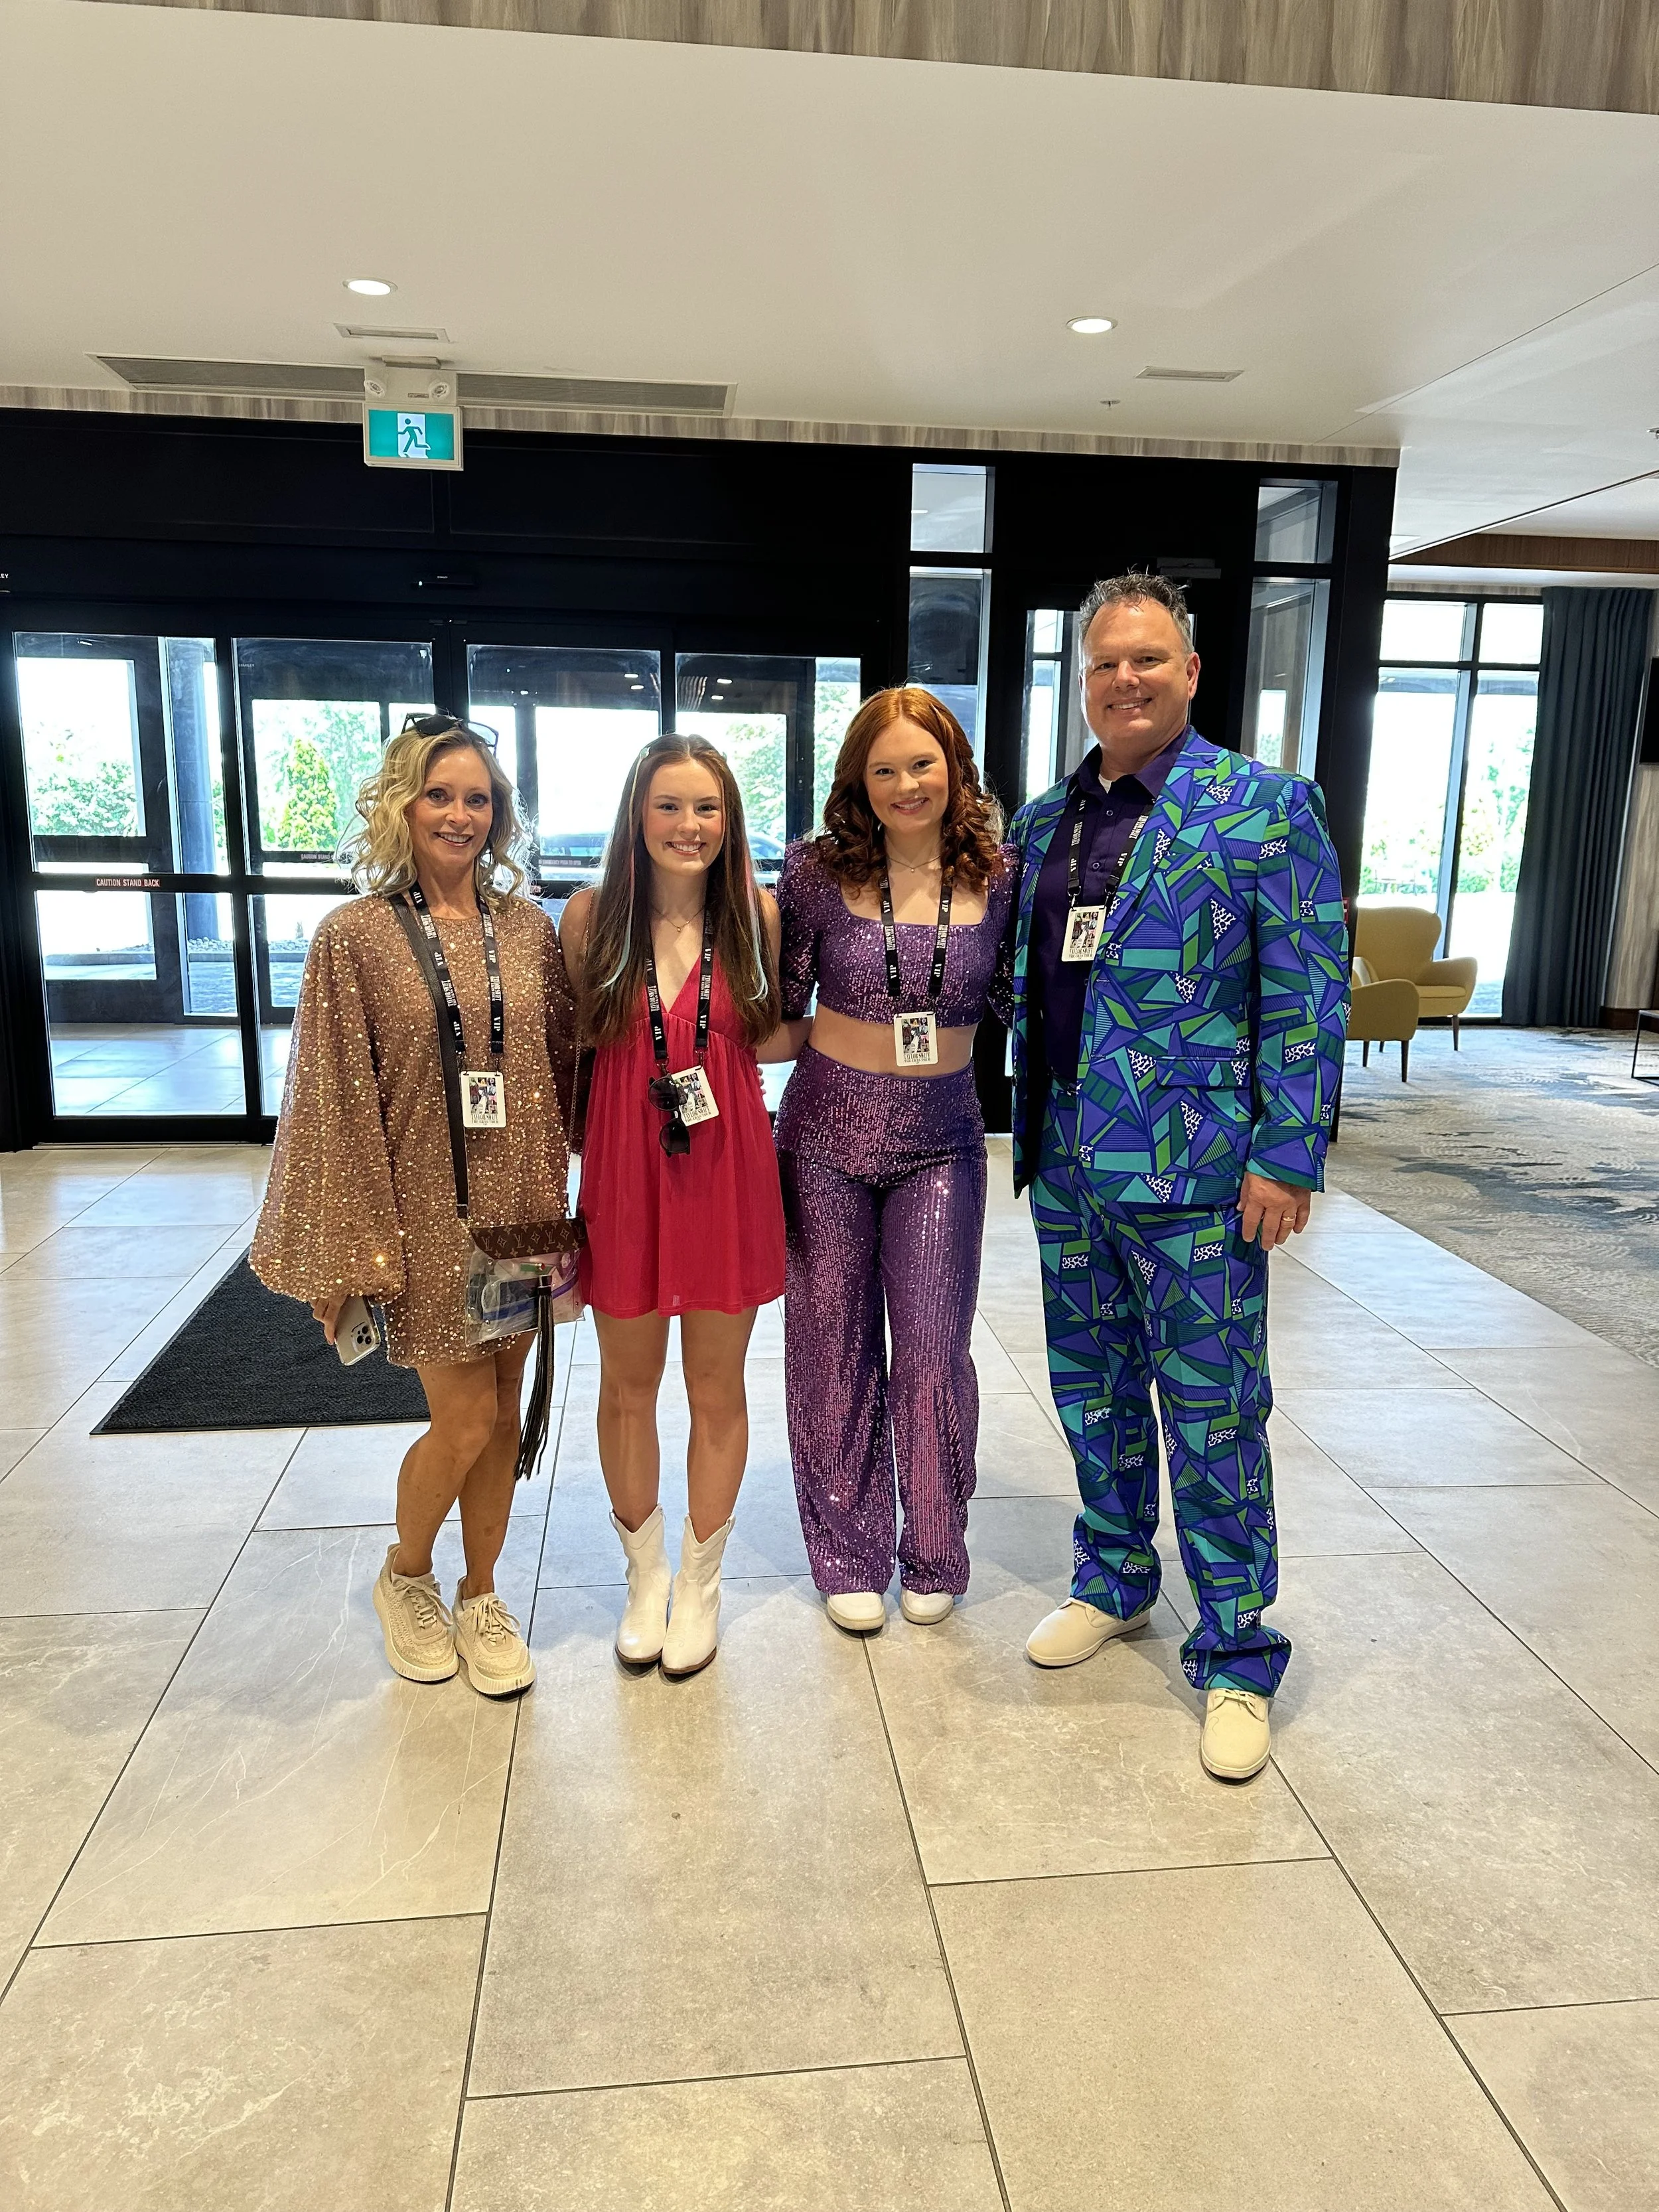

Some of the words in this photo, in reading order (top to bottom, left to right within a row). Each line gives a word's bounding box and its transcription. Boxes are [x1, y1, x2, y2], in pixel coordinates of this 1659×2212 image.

[1117, 852, 1127, 867] VIP
[413, 892, 423, 903] VIP
[434, 952, 444, 966] VIP
[654, 1026, 662, 1041] VIP
